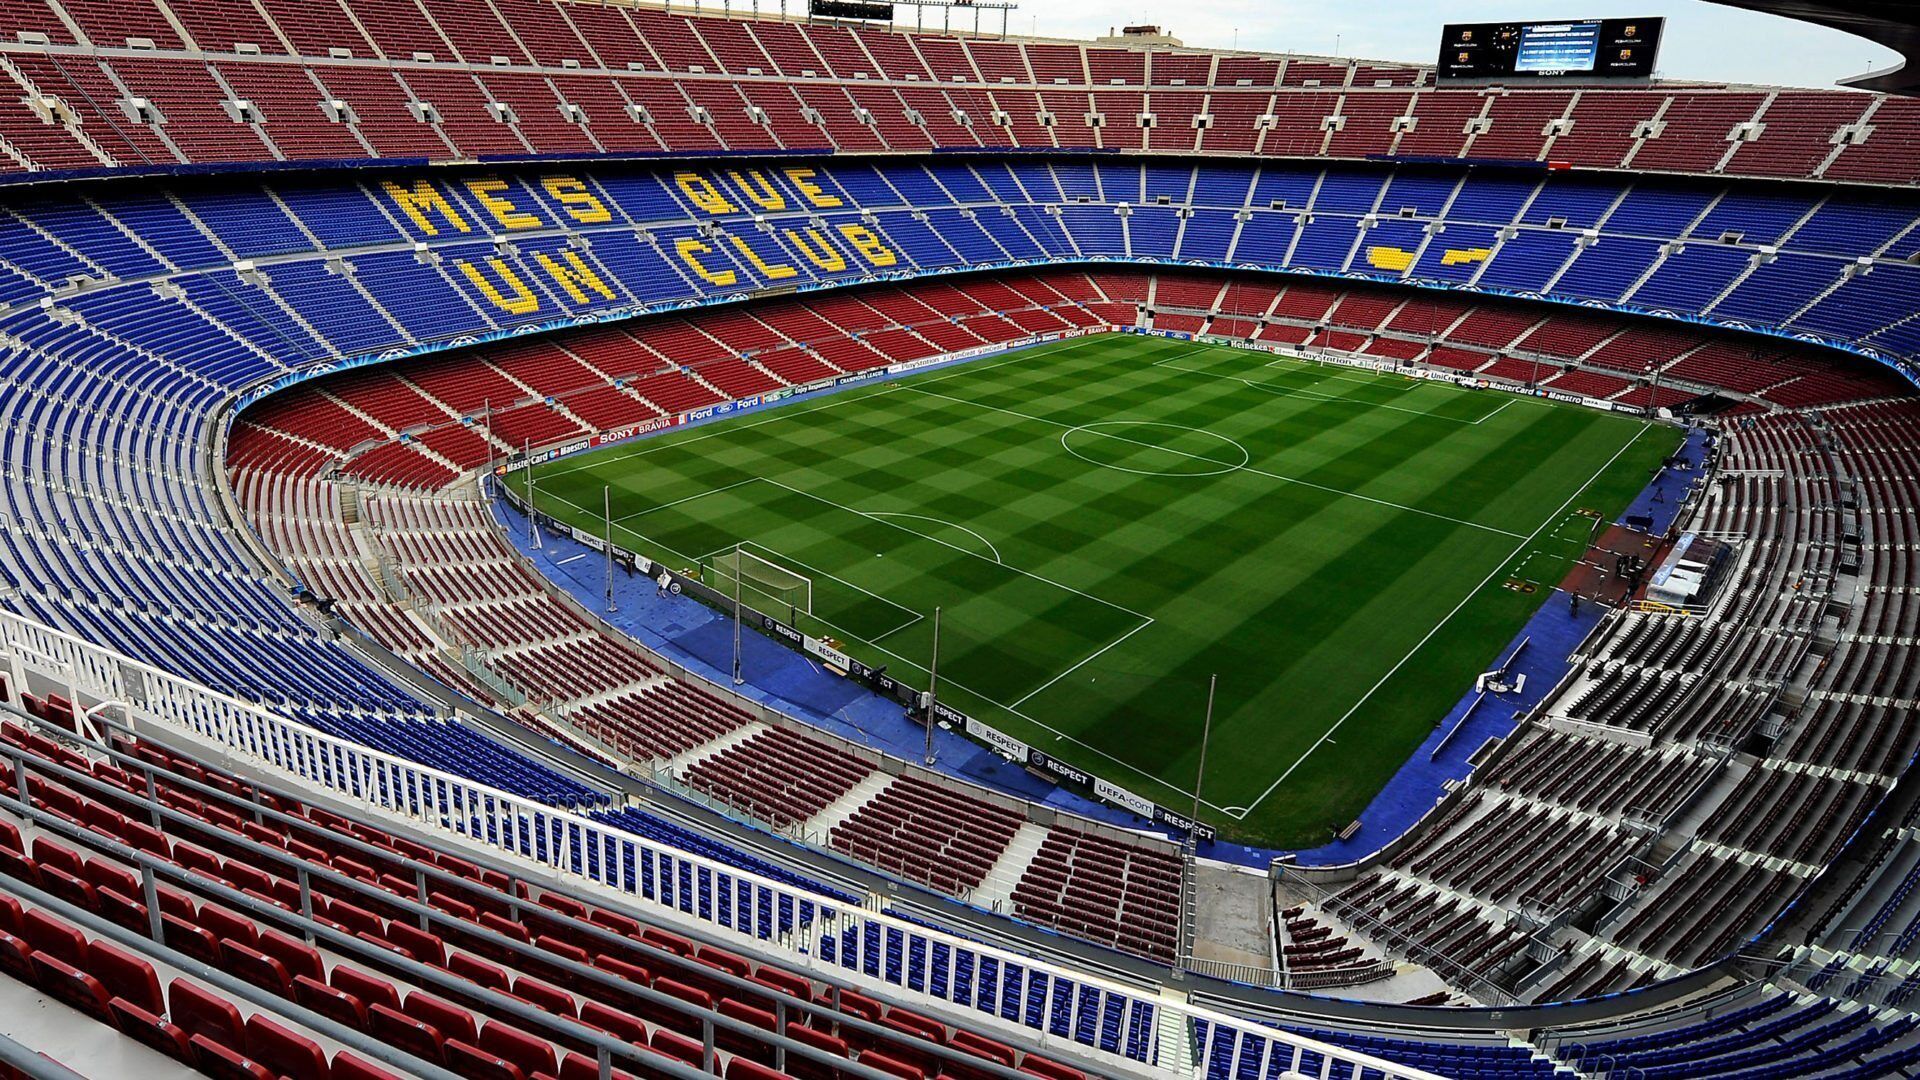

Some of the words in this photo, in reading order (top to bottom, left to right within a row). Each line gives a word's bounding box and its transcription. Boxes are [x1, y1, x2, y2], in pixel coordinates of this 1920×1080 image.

[380, 175, 612, 236] MES
[674, 168, 844, 214] QUE
[454, 250, 616, 315] UN
[675, 225, 897, 286] CLUB
[1065, 330, 1087, 338] SONY
[1145, 328, 1166, 337] Ford
[1231, 340, 1268, 352] Heineken
[902, 356, 940, 370] PlayStation
[1383, 363, 1418, 376] Unredit
[1489, 382, 1535, 396] MasterCard
[737, 397, 758, 410] Ford
[1548, 391, 1582, 404] Maestro
[690, 409, 713, 421] Ford
[1616, 405, 1640, 415] RESPECT
[600, 428, 635, 444] SONY
[639, 418, 671, 434] BRAVIA
[560, 440, 588, 456] Maestro
[553, 521, 571, 534] RESPECT
[582, 534, 601, 546] RESPECT
[775, 624, 802, 642] RESPECT
[818, 646, 845, 665] RESPECT
[934, 704, 963, 724] ESPECT
[986, 730, 1022, 754] RESPECT
[1047, 760, 1088, 785] RESPECT
[1164, 812, 1214, 839] RESPECT
